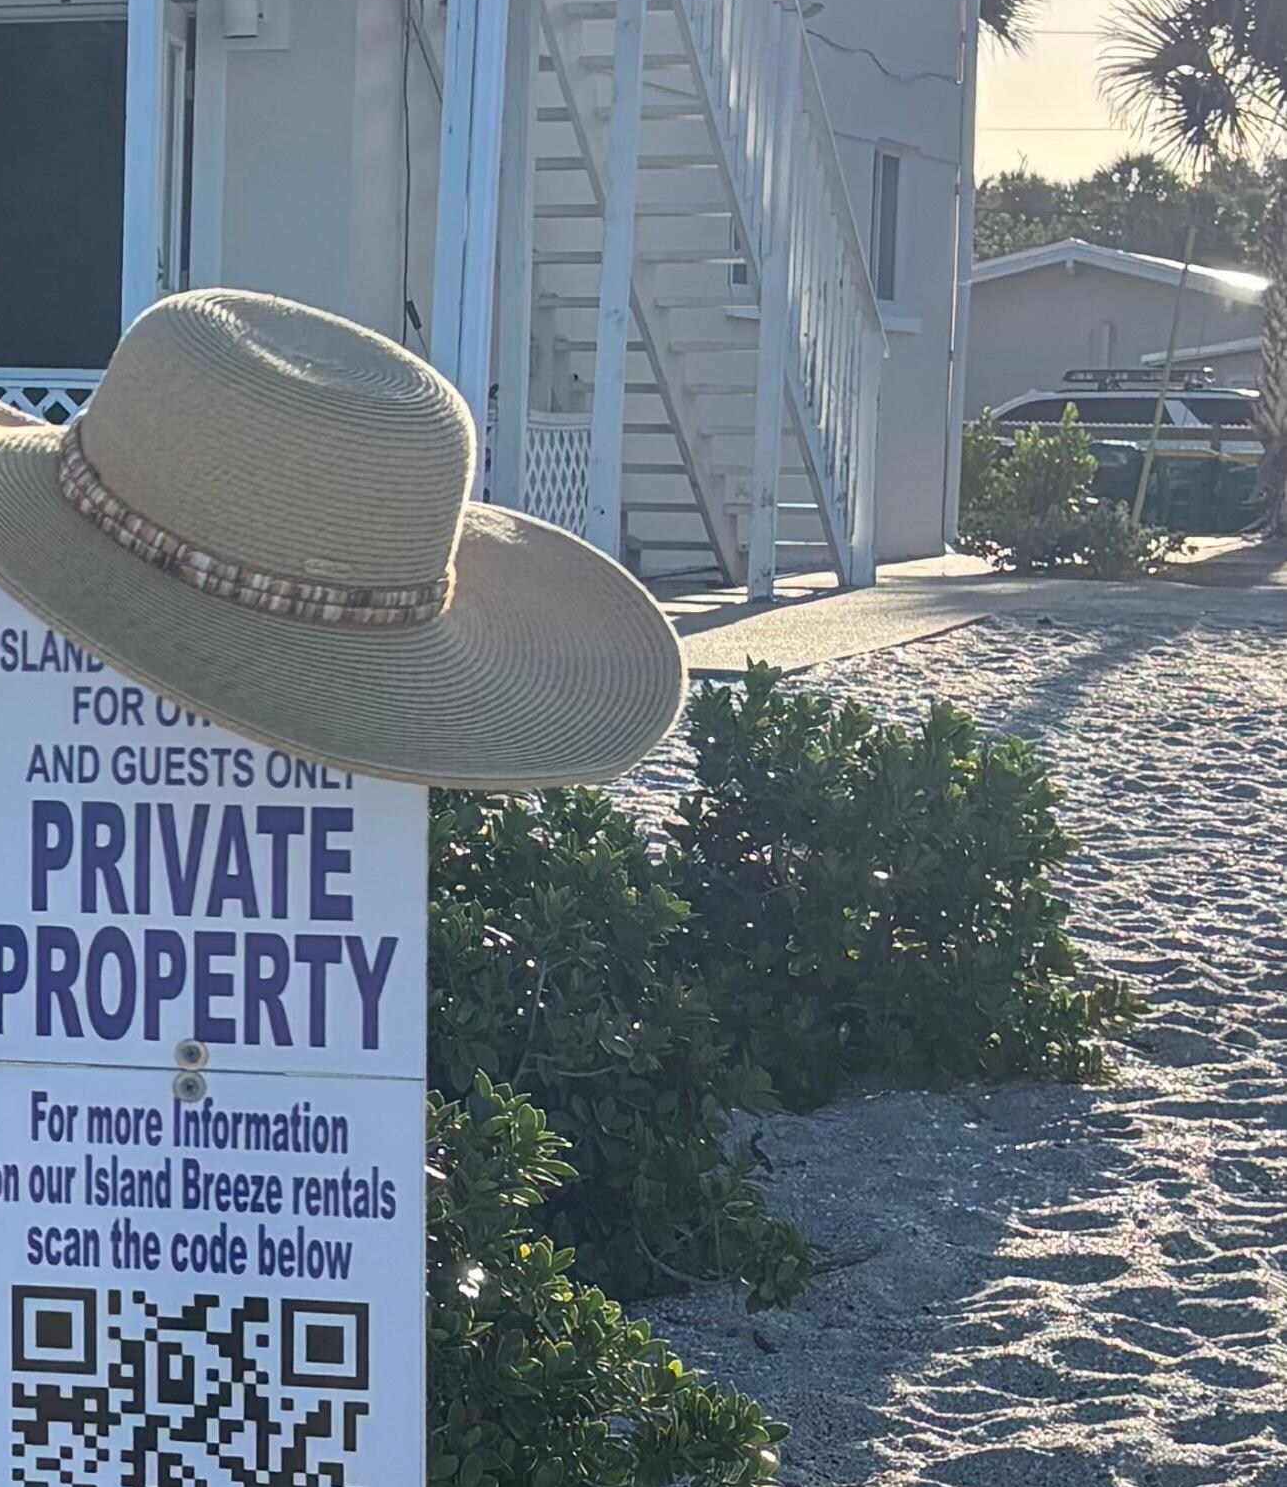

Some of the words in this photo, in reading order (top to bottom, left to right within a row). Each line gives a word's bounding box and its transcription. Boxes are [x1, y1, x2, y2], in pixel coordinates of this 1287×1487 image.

[72, 686, 144, 727] FOR
[25, 744, 100, 784] AND
[111, 744, 255, 788] GUESTS
[31, 800, 354, 922] PRIVATE
[31, 1090, 78, 1143] For
[87, 1103, 163, 1148] more
[172, 1096, 349, 1154] Information
[29, 1163, 77, 1205] our
[84, 1154, 172, 1209] Island
[182, 1157, 283, 1214] Breeze
[292, 1165, 397, 1220] rentals
[27, 1224, 100, 1268] scan
[110, 1217, 161, 1271] the
[171, 1222, 248, 1275] code
[258, 1223, 353, 1280] below
